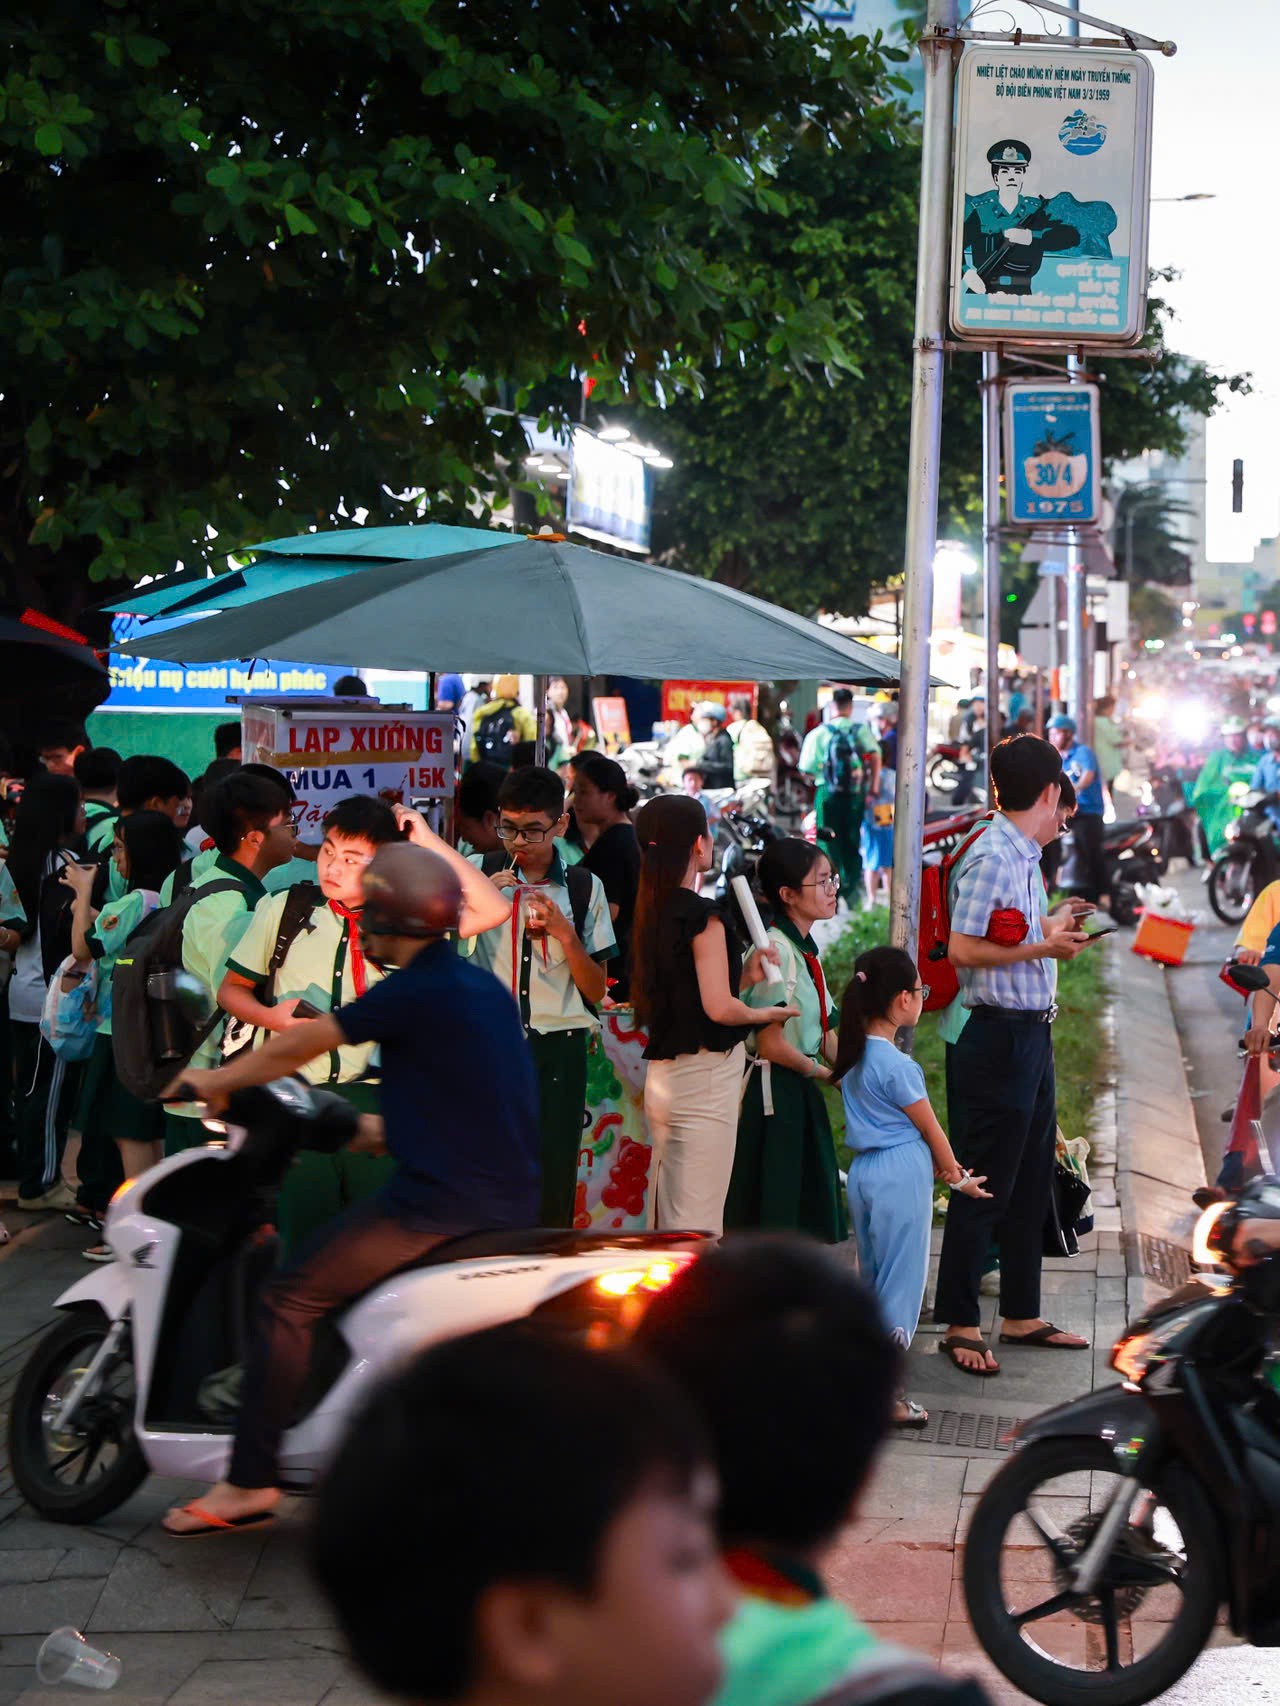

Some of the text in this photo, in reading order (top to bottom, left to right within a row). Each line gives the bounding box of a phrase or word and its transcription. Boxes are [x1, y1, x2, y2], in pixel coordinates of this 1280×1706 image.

[976, 63, 994, 80] NHIỆT
[995, 63, 1009, 80] LIỆT
[1111, 68, 1132, 84] THỐNG
[995, 82, 1005, 99] BỘ
[1053, 84, 1067, 101] VIỆT
[1067, 87, 1081, 100] NAM
[1035, 463, 1073, 486] 30/4
[1026, 501, 1083, 513] 1975
[289, 727, 340, 753] LAP
[287, 769, 375, 791] MUA 1
[409, 768, 445, 788] 15K
